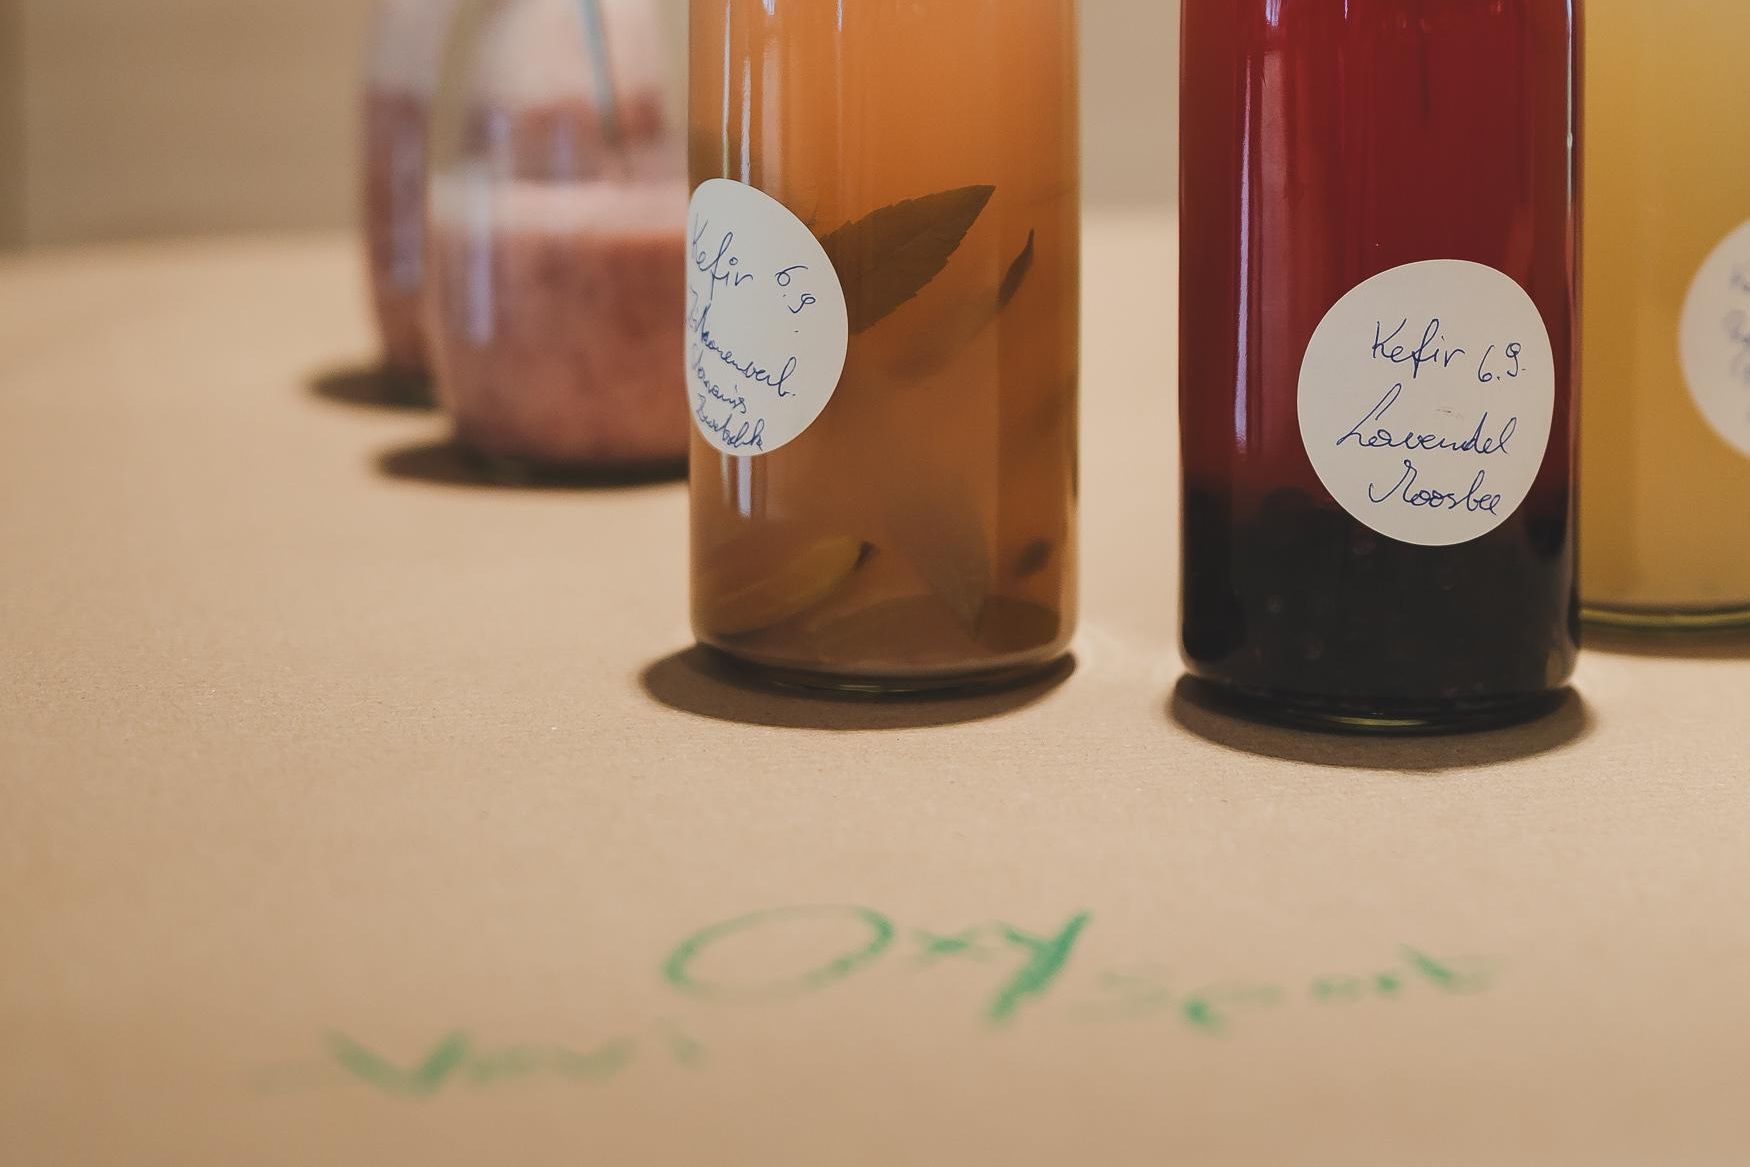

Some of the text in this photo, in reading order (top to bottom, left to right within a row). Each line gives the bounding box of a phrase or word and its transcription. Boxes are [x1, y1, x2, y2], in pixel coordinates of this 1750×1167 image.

[690, 213, 754, 301] Kefir
[1372, 317, 1465, 379] Kefir
[1336, 382, 1518, 456] Lavendel
[660, 901, 1093, 1035] Oxy
